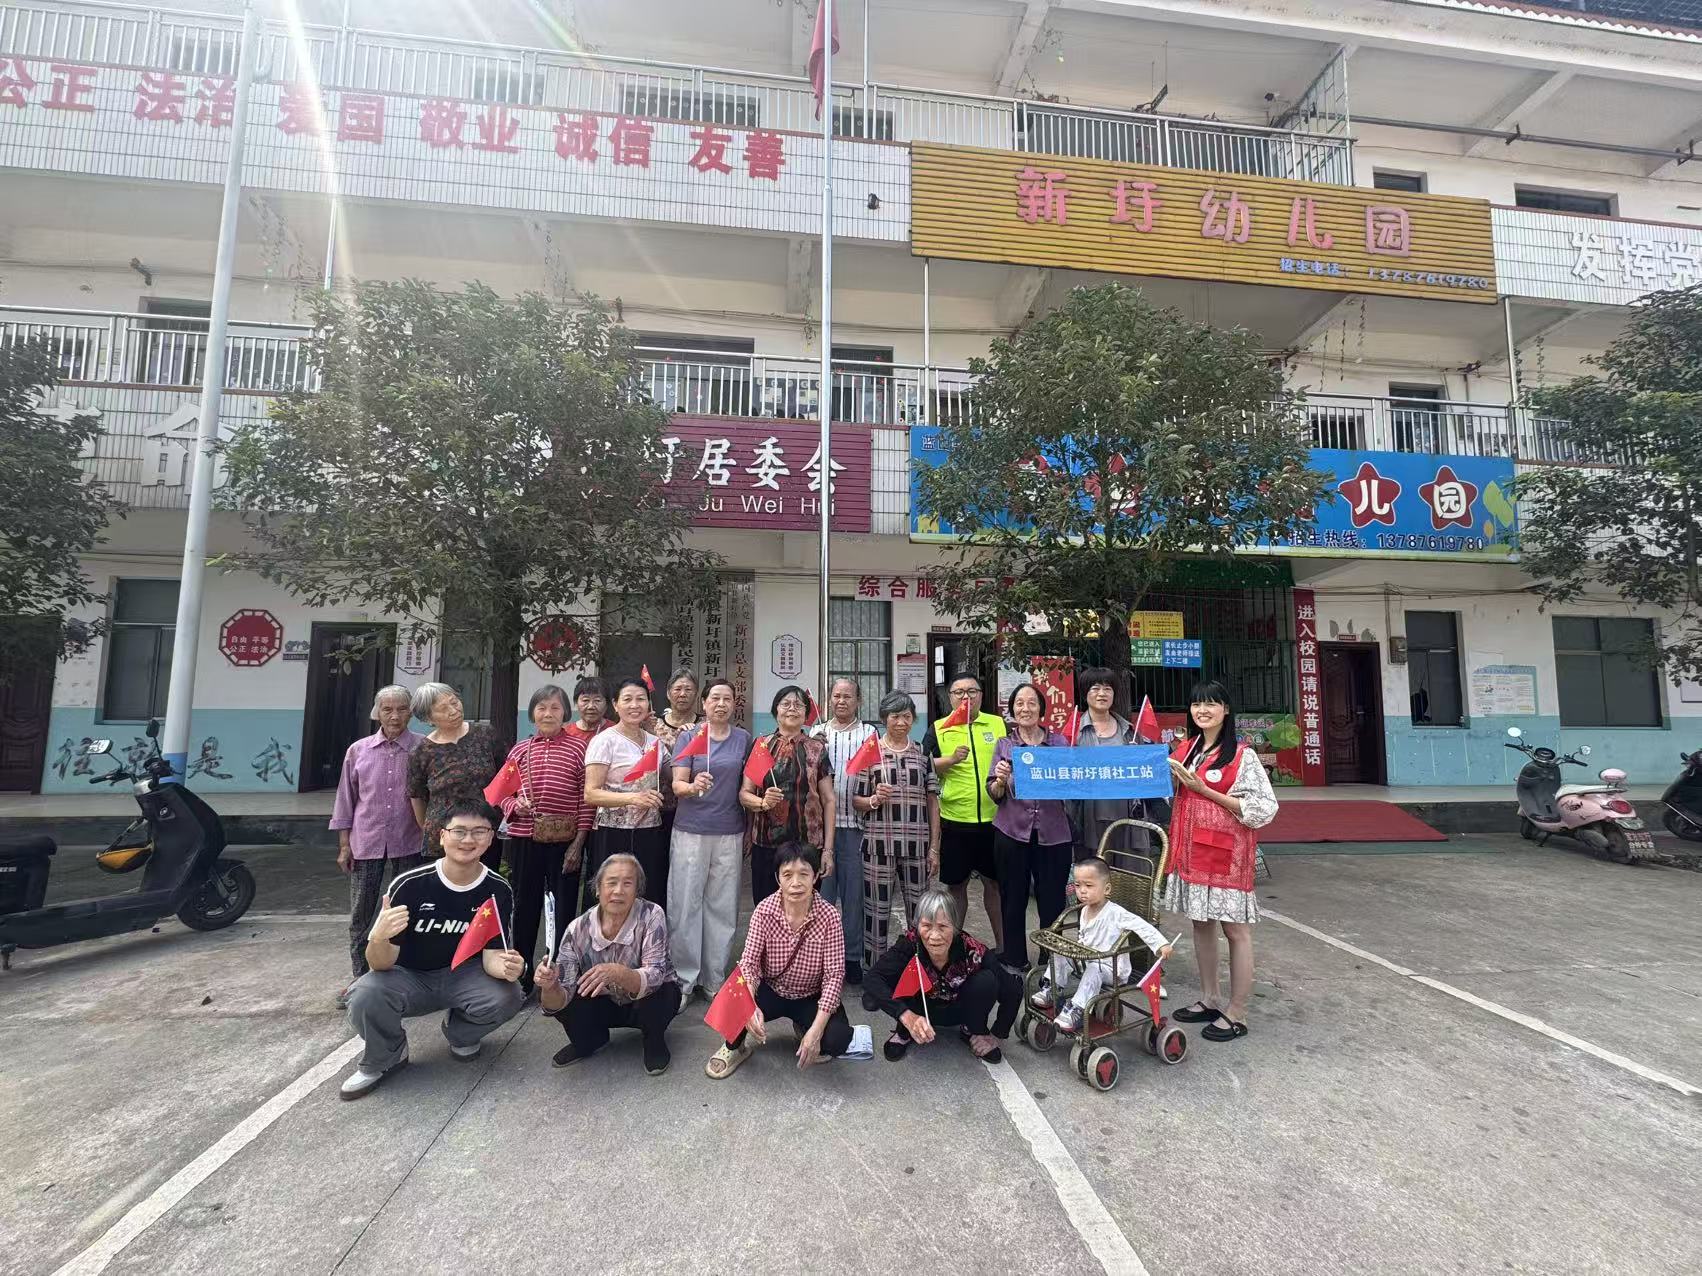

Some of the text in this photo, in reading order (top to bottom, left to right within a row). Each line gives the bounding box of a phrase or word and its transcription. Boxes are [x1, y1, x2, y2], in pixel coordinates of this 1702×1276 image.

[0, 58, 97, 112] 公正
[134, 70, 236, 129] 法治
[419, 98, 520, 154] 敬业
[554, 112, 655, 168] 诚信
[688, 125, 785, 182] 友善
[1014, 166, 1411, 257] 新圩幼儿园
[1367, 266, 1489, 289] 13787619780
[740, 495, 784, 514] Wei
[1377, 532, 1484, 551] 13787619780
[1297, 604, 1322, 766] 进入校园请说普通话
[1030, 765, 1154, 780] 蓝山县新圩镇社工站
[414, 918, 470, 934] LI-NIN
